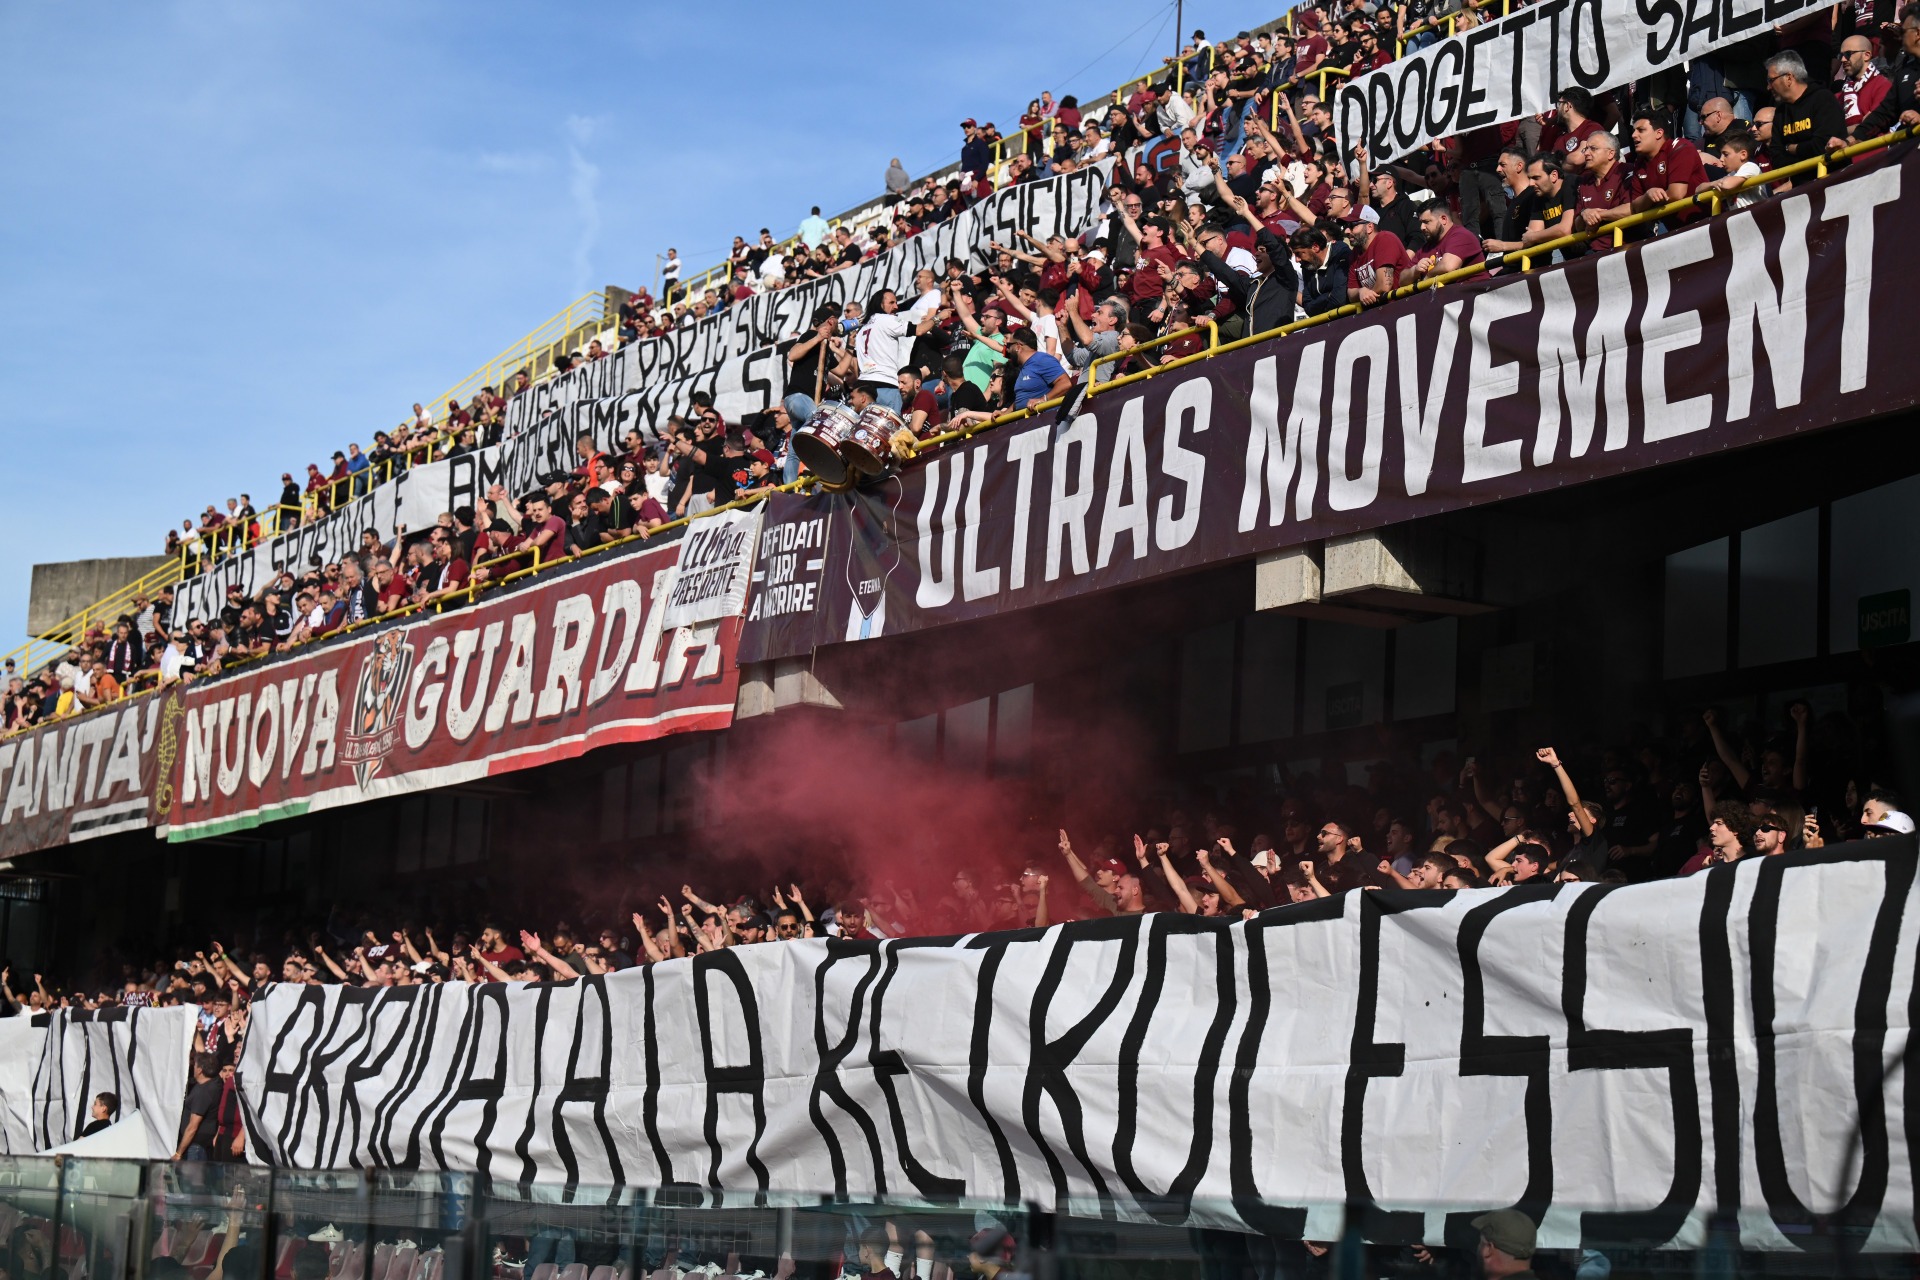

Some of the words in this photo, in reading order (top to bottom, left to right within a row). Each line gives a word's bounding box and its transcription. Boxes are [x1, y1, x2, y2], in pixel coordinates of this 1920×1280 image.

[1340, 0, 1610, 179] PROGETTO
[1782, 117, 1812, 137] SALRNO
[915, 376, 1213, 609] ULTRAS
[1237, 163, 1902, 534] MOVEMENT
[392, 470, 410, 535] E
[761, 518, 824, 559] DFFIDATI
[749, 592, 762, 622] A
[763, 582, 817, 618] MORIRE
[181, 667, 341, 806] NUOVA
[809, 832, 1920, 1254] RETROCESSIO
